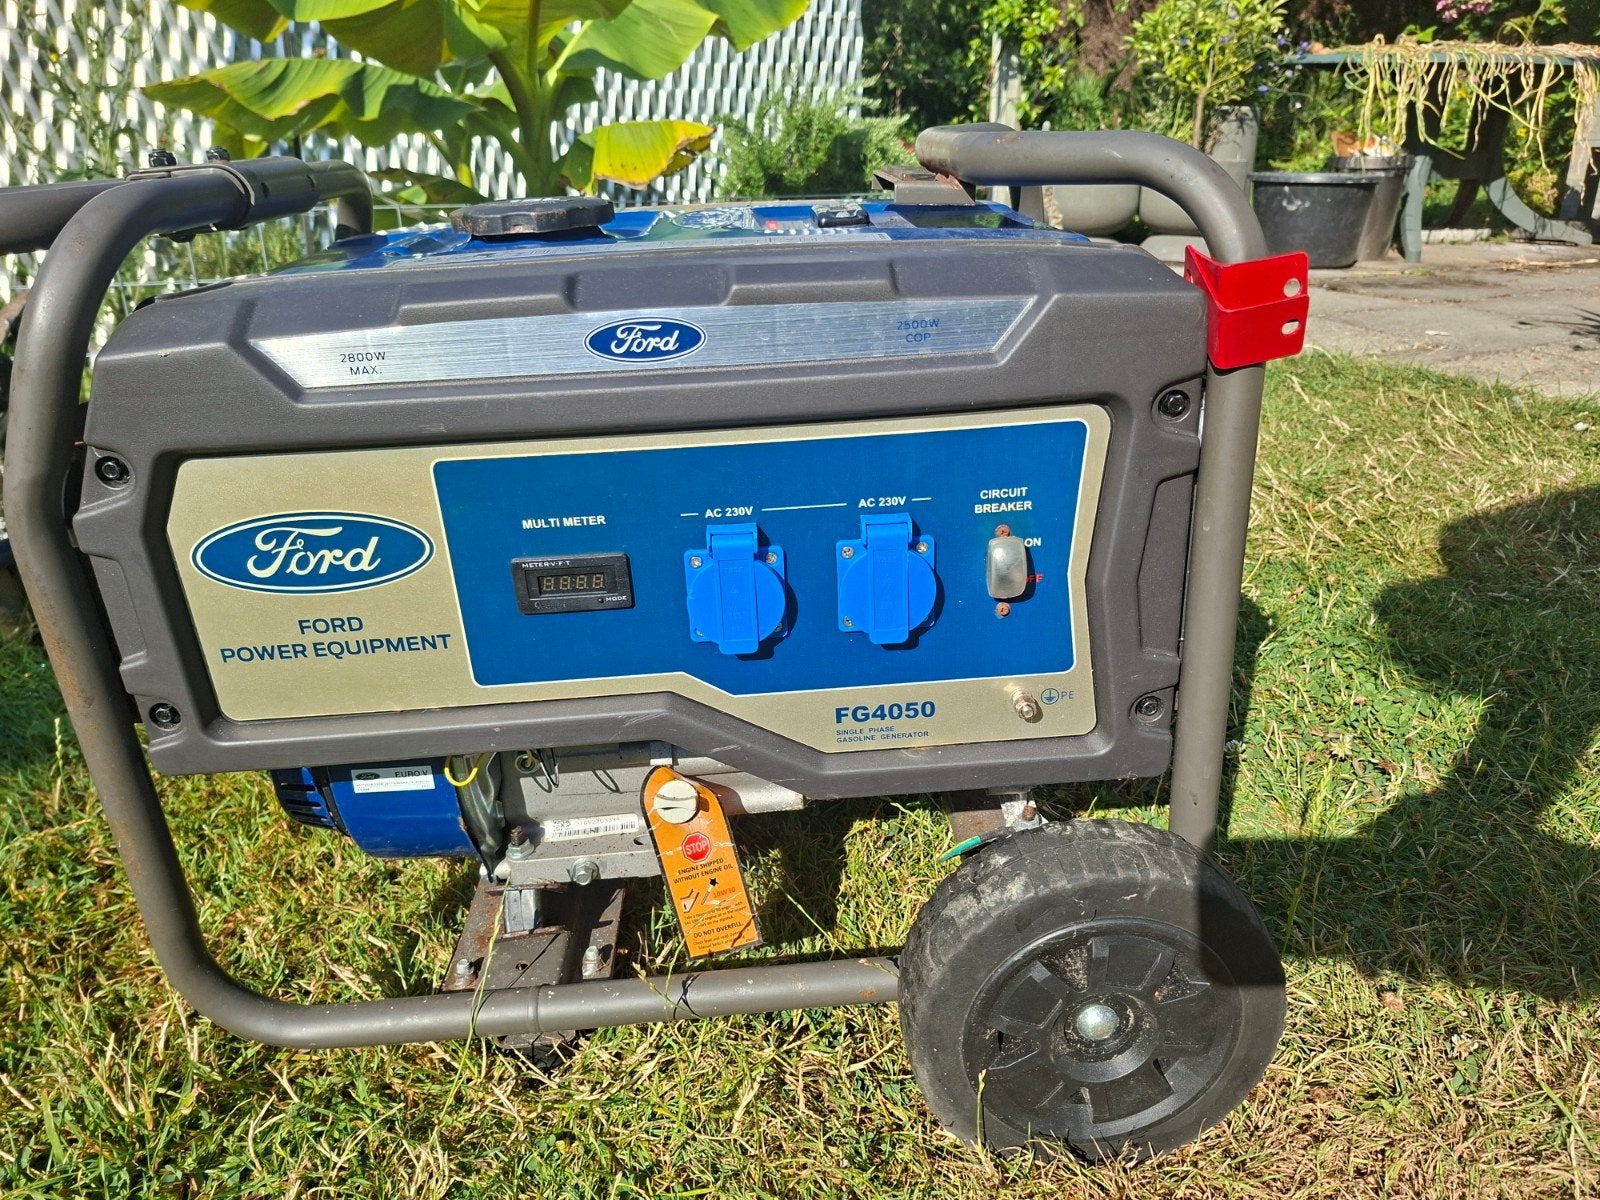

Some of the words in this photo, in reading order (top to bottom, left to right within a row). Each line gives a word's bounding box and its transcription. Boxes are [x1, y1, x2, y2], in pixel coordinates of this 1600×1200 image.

[896, 318, 940, 331] 2500W
[610, 324, 680, 354] Ford
[905, 332, 932, 343] COP
[340, 351, 387, 363] 2800W
[349, 364, 383, 376] MAX.
[980, 487, 1028, 500] CIRCUIT
[858, 497, 876, 508] AC
[878, 495, 907, 507] 230V
[974, 501, 1032, 514] BREAKER
[704, 508, 723, 519] AC
[725, 505, 754, 517] 230V
[522, 518, 560, 529] MULTI
[563, 515, 606, 527] METER
[1024, 537, 1042, 547] ON
[247, 526, 381, 578] Ford
[1026, 573, 1044, 583] FF
[298, 616, 363, 635] FORD
[220, 643, 308, 664] POWER
[313, 633, 451, 659] EQUIPMENT
[1060, 690, 1075, 700] PE
[835, 700, 936, 724] FG4050
[836, 727, 864, 736] SINGLE
[868, 725, 895, 733] PHASE
[836, 734, 876, 744] GASOLINE
[880, 731, 929, 740] GENERATOR
[394, 770, 420, 778] EURO
[685, 840, 707, 855] STOP
[678, 864, 699, 875] ENGINE
[700, 858, 724, 869] SHIPPED
[674, 872, 700, 884] WITHOUT
[700, 866, 722, 877] ENGINE
[703, 928, 715, 936] NOT
[716, 922, 744, 933] OVERFILL.
